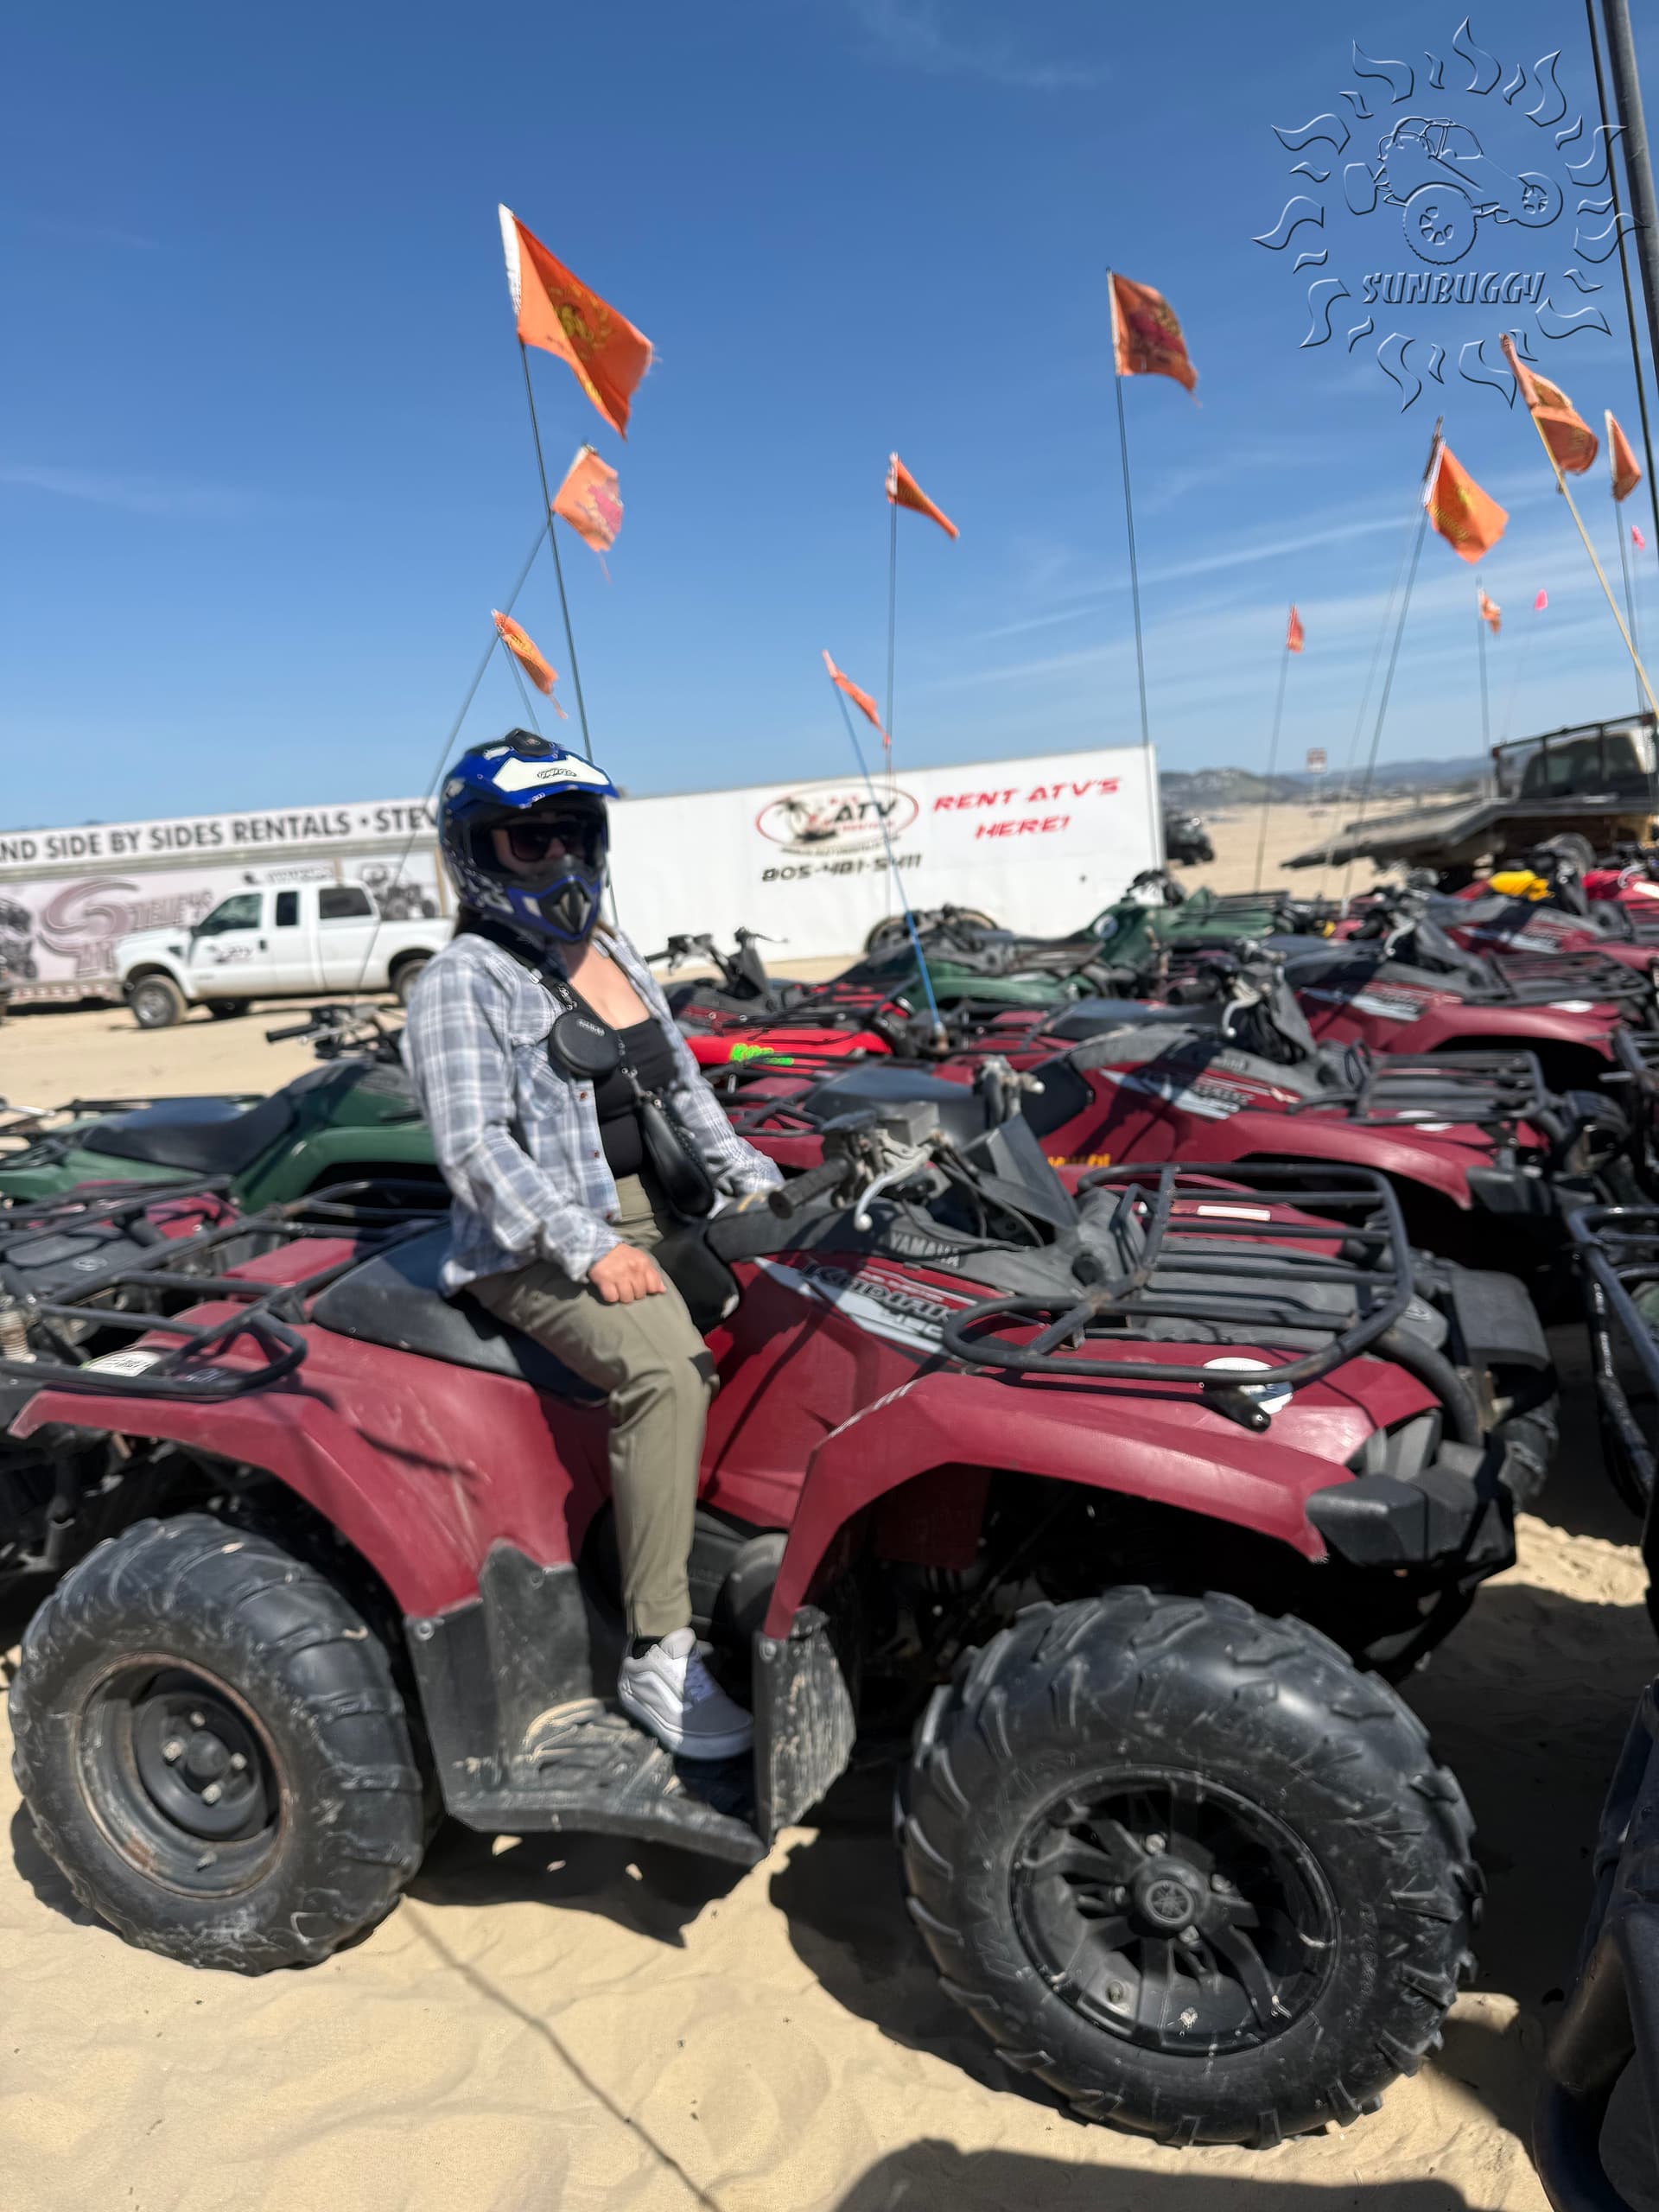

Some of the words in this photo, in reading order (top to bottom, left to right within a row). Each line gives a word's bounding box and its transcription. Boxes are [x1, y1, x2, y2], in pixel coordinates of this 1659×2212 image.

[834, 797, 899, 823] ATV
[933, 788, 1018, 812] RENT
[1027, 777, 1121, 803] ATV'S
[0, 838, 37, 861] ND
[46, 832, 102, 859] SIDE
[110, 830, 142, 854] BY
[149, 823, 224, 850] SIDES
[233, 810, 353, 843] RENTALS
[974, 815, 1071, 840] HERE!
[888, 1230, 962, 1268] YAMAHA
